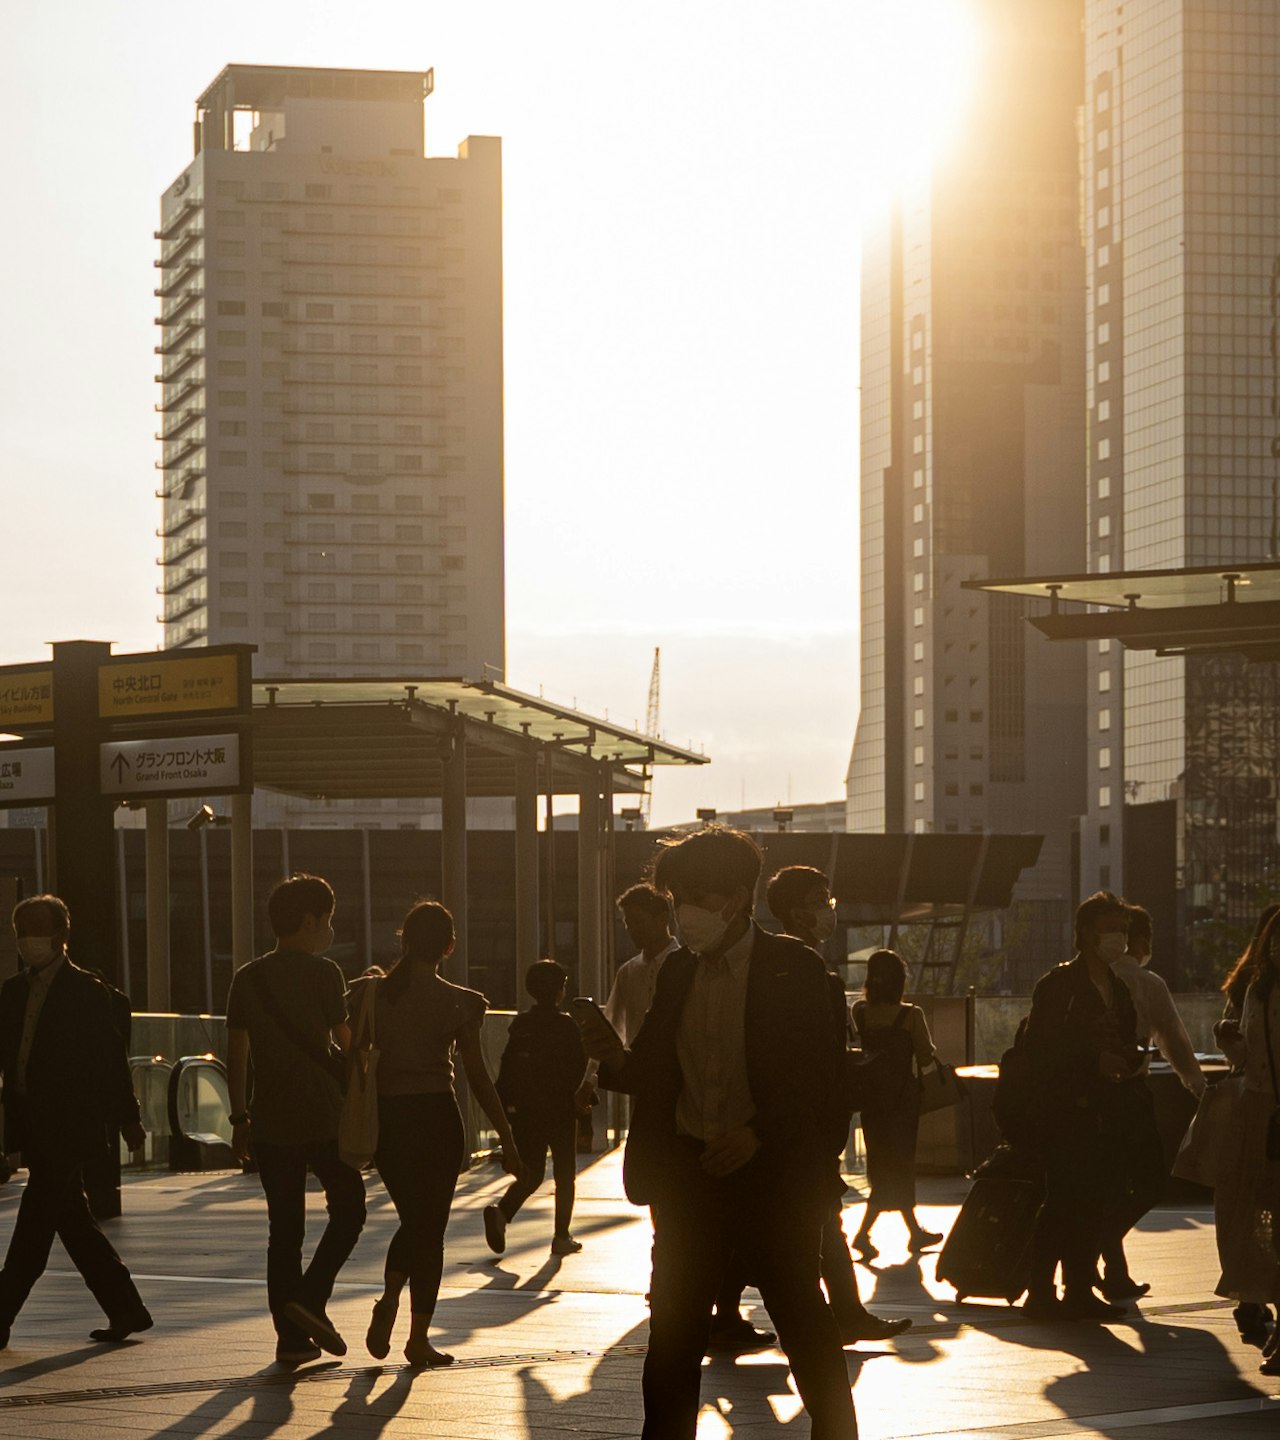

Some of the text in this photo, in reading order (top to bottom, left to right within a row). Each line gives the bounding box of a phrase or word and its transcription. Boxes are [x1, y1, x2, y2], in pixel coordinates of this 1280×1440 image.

[113, 674, 161, 693] 中央北口
[113, 695, 133, 705] North
[135, 693, 160, 704] Central
[161, 692, 178, 703] Gate
[14, 703, 42, 714] Building
[136, 747, 226, 768] グランフロント大阪
[136, 767, 208, 782] Grand Front Osaka
